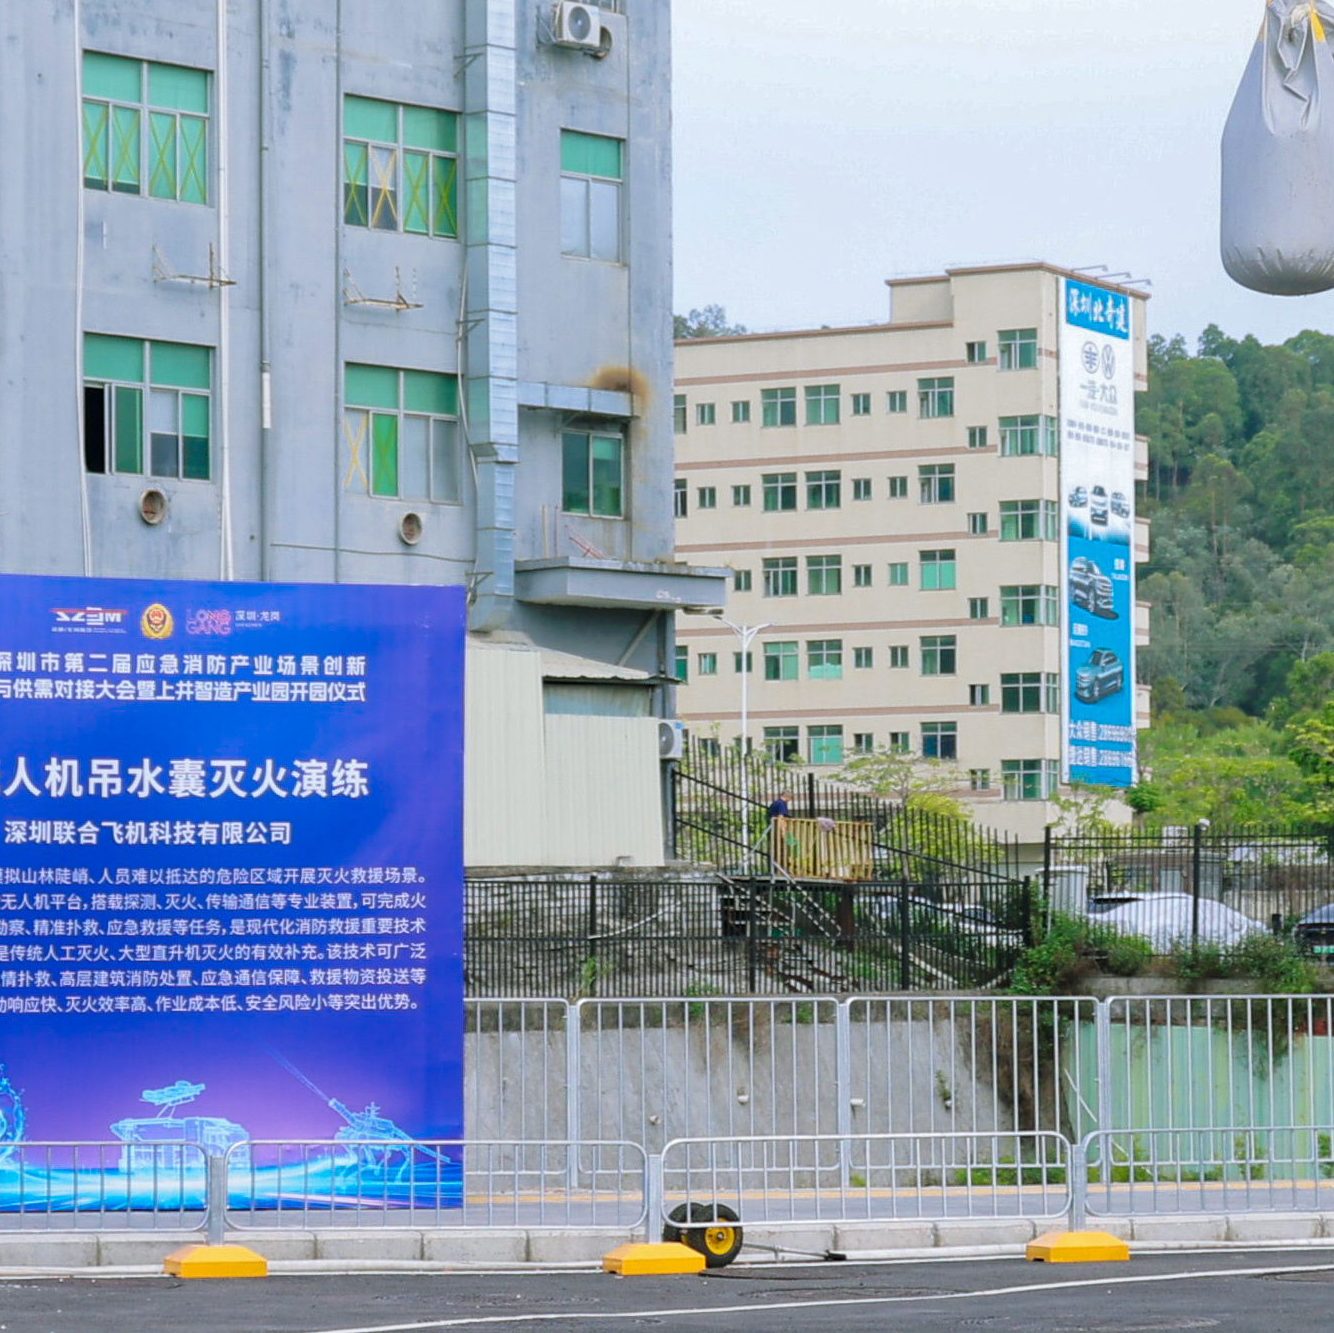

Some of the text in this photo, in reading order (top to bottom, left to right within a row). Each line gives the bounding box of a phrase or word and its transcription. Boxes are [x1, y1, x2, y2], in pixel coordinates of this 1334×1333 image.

[186, 609, 232, 622] LONG
[186, 621, 232, 635] GANG
[4, 820, 291, 846] 深圳联合飞机科技有限公司
